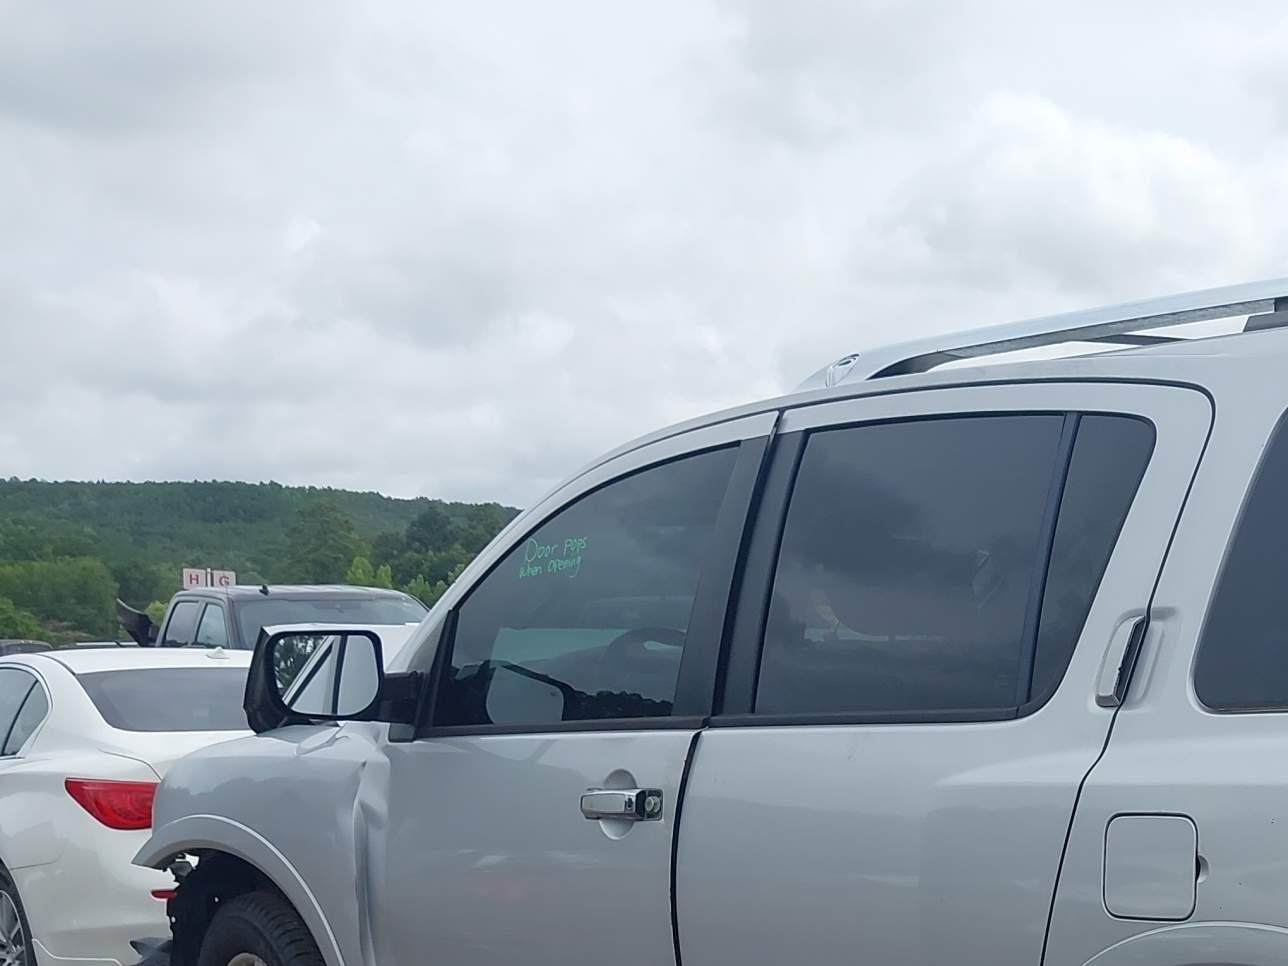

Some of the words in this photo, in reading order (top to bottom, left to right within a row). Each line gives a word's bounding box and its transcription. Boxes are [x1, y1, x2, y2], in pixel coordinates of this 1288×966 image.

[525, 537, 559, 562] Door
[189, 573, 200, 585] H
[219, 575, 230, 586] G
